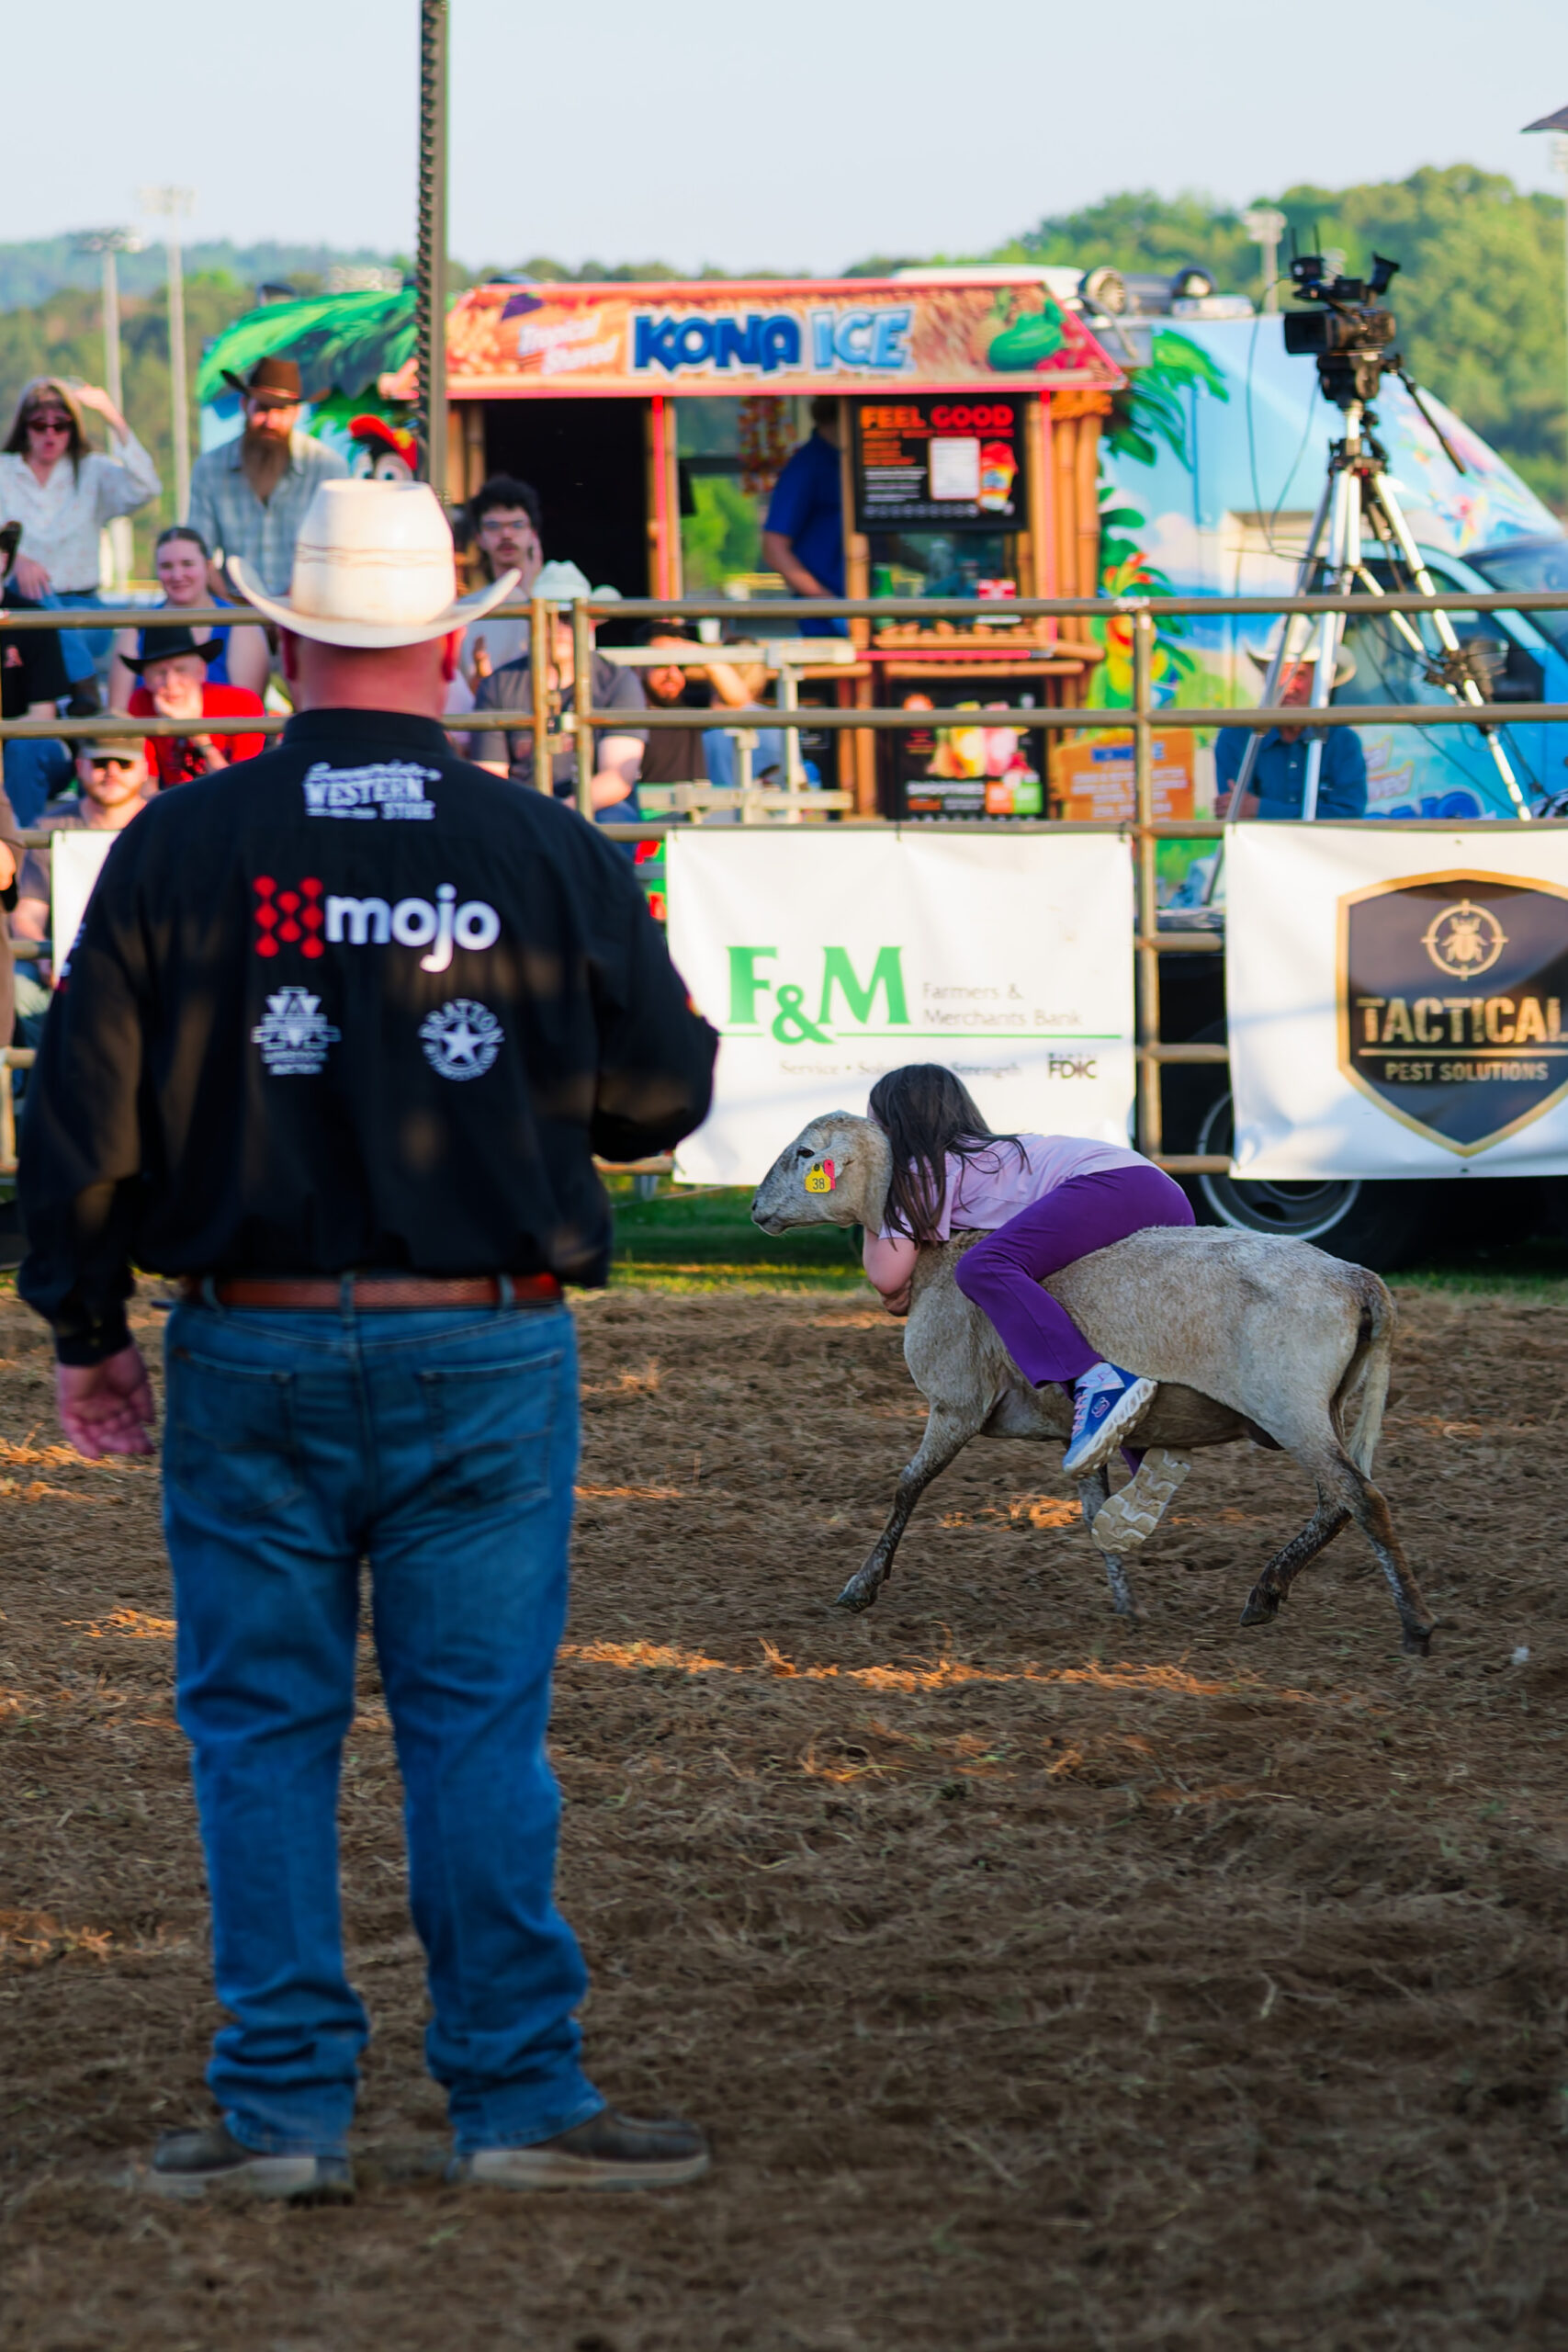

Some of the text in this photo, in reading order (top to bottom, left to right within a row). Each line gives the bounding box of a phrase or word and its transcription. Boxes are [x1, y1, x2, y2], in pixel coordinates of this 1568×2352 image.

[634, 314, 800, 372] KONA
[811, 310, 910, 368] ICE
[861, 404, 1014, 428] FEEL GOOD
[304, 778, 424, 808] WESTERN
[325, 882, 501, 973] mojo
[922, 982, 1023, 1000] Farmers &
[922, 1009, 1083, 1026] Merchants Bank
[1356, 996, 1568, 1044] TACTICAL
[1047, 1059, 1098, 1080] FDIC
[1385, 1062, 1549, 1082] PEST SOLUTIONS
[812, 1177, 825, 1190] 38
